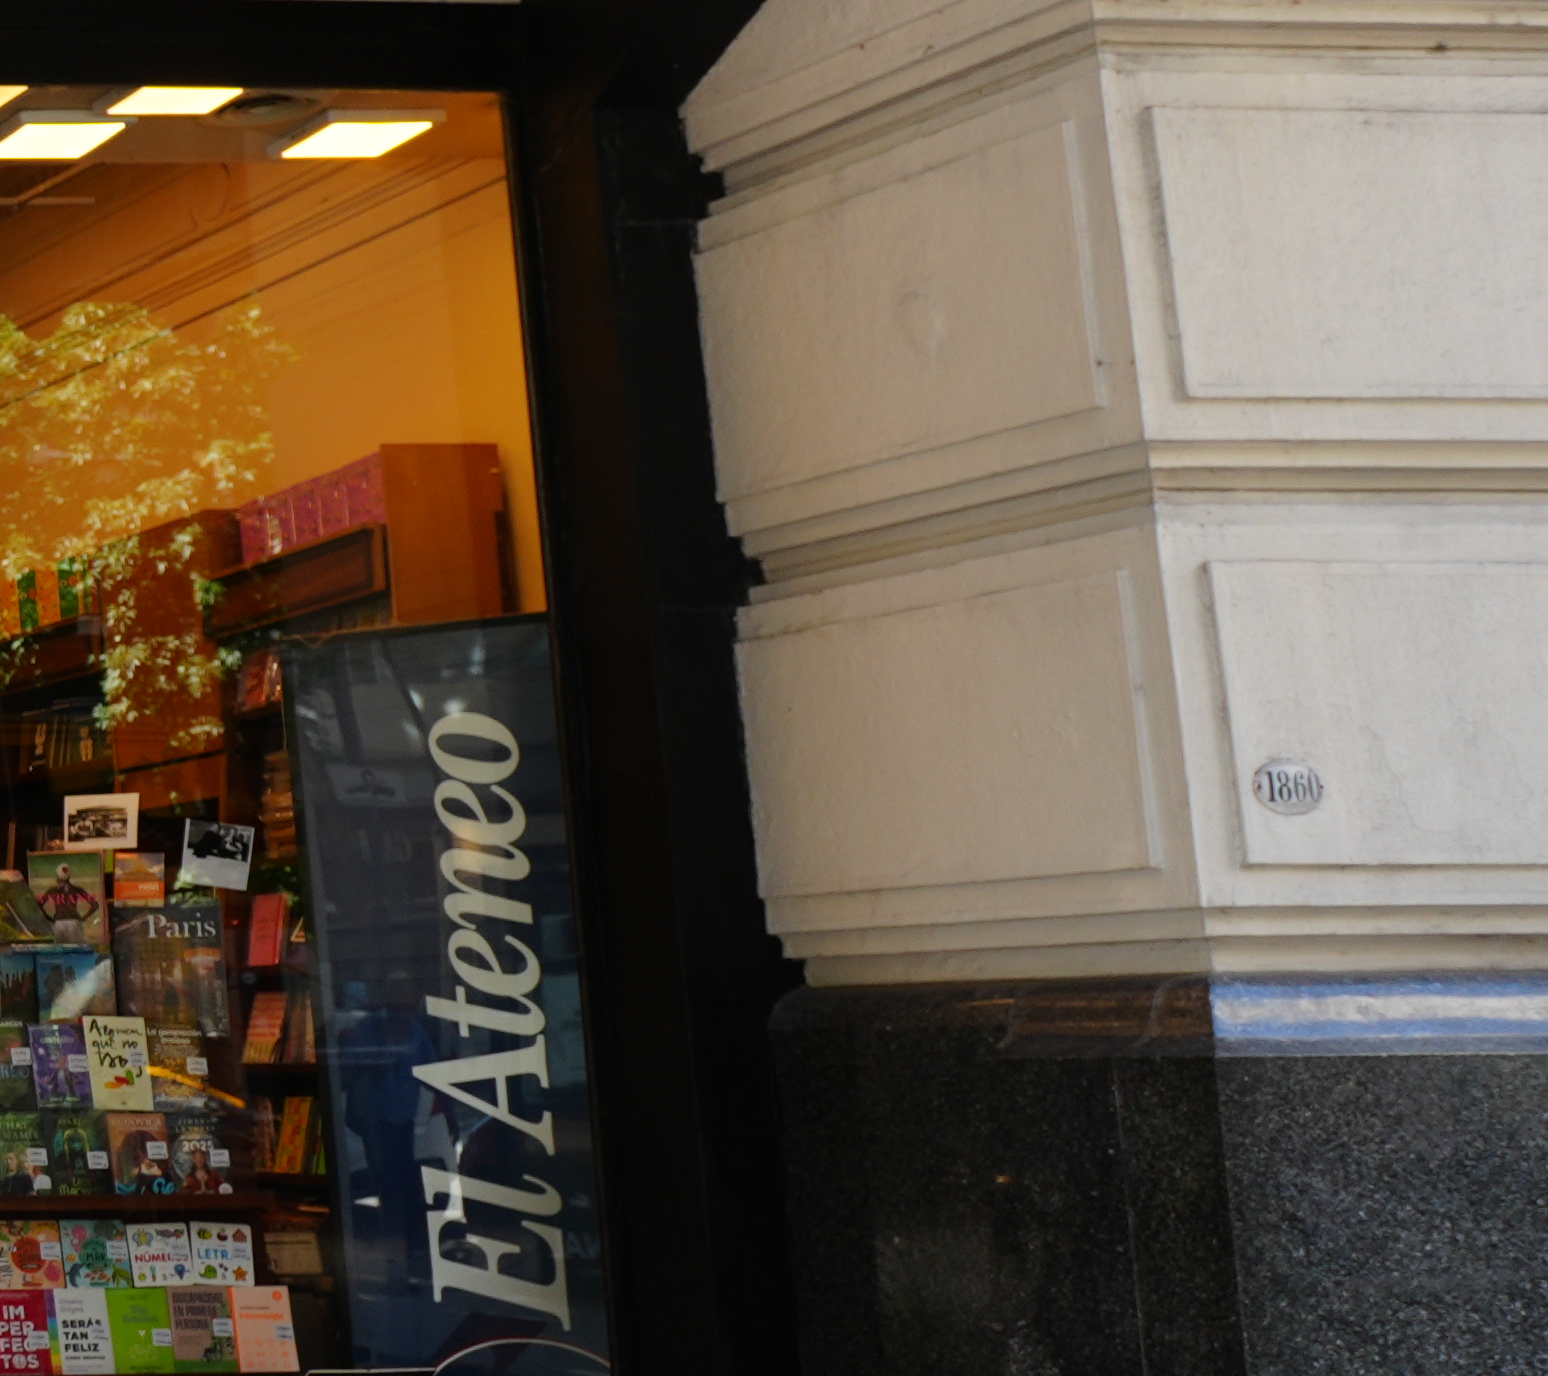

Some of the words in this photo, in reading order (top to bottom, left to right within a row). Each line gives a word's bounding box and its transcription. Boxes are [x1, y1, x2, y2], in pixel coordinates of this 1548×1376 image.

[1265, 770, 1323, 803] 1860
[145, 912, 218, 939] Paris
[412, 710, 552, 1157] Ateneo
[420, 1159, 572, 1332] El
[1, 1304, 26, 1320] IM
[62, 1331, 90, 1341] TAN
[0, 1353, 40, 1370] TOS
